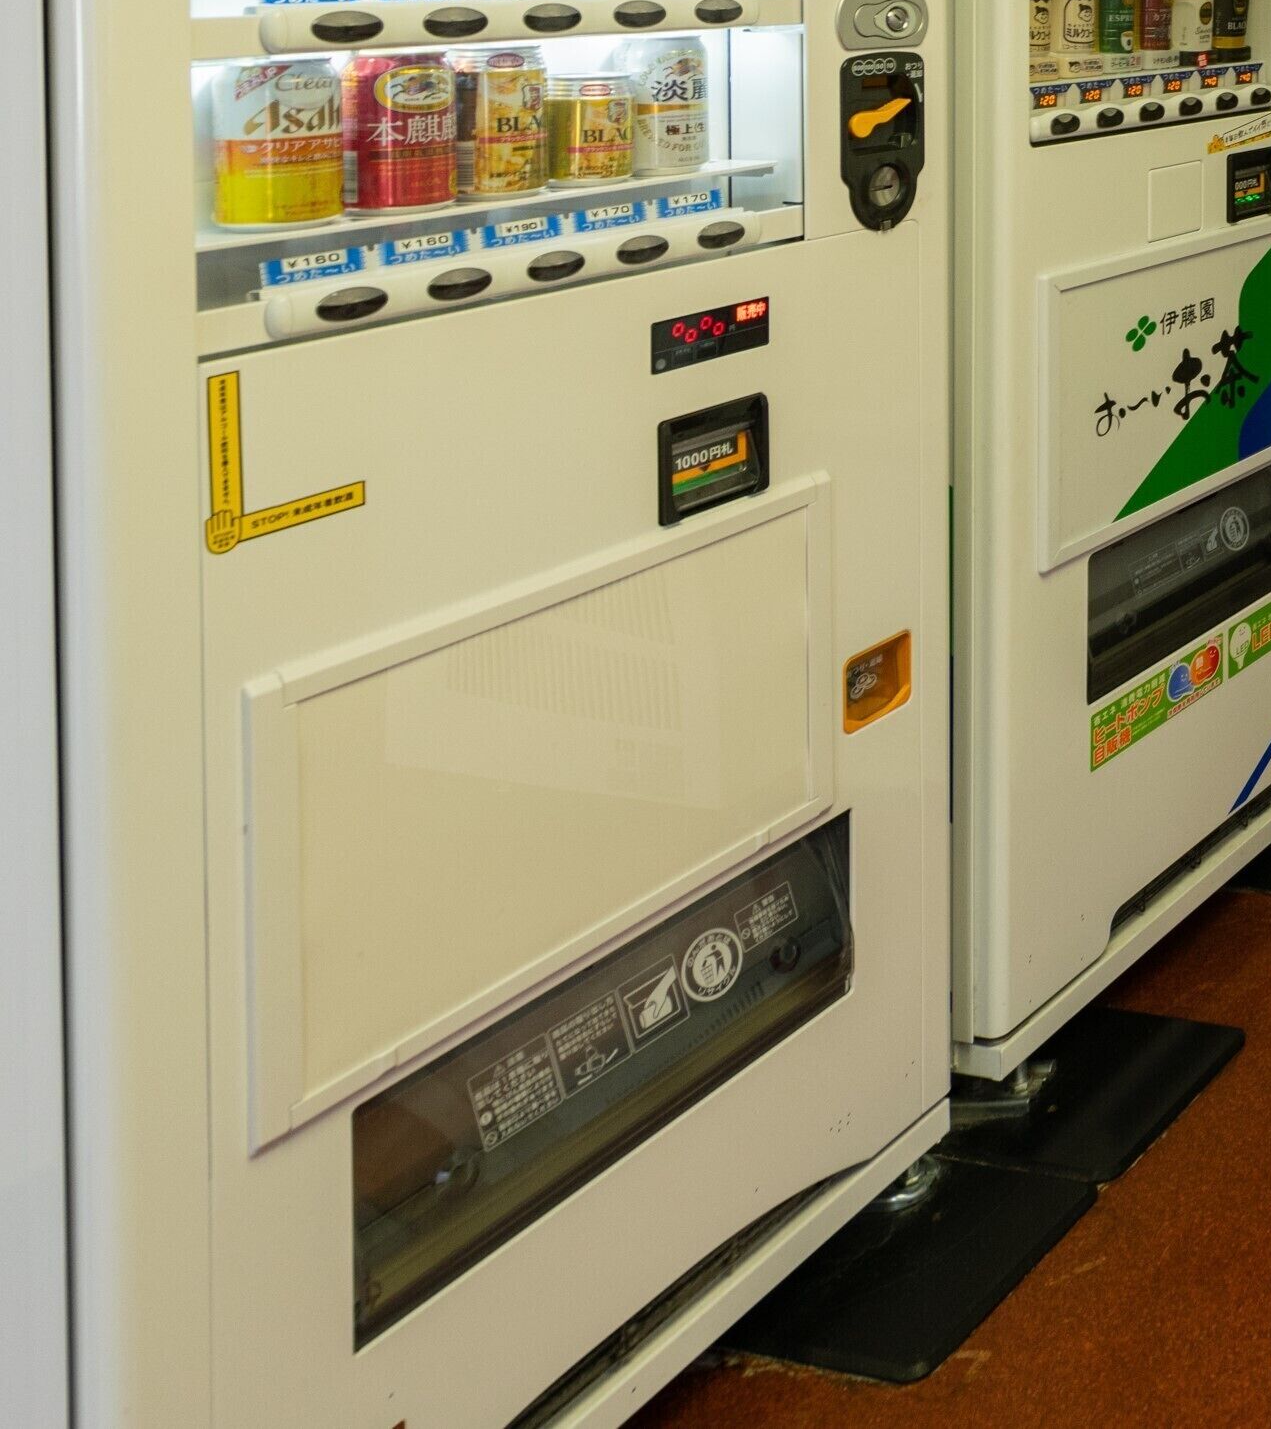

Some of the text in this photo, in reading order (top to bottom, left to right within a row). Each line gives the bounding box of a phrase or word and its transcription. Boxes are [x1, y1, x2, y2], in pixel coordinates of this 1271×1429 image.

[672, 192, 709, 206] ¥170
[590, 203, 632, 219] ¥170
[505, 221, 539, 235] ¥190
[735, 301, 767, 322] 販売中
[1159, 296, 1216, 336] 伊藤園
[674, 441, 735, 471] 1000円札
[1092, 725, 1132, 768] 自販機
